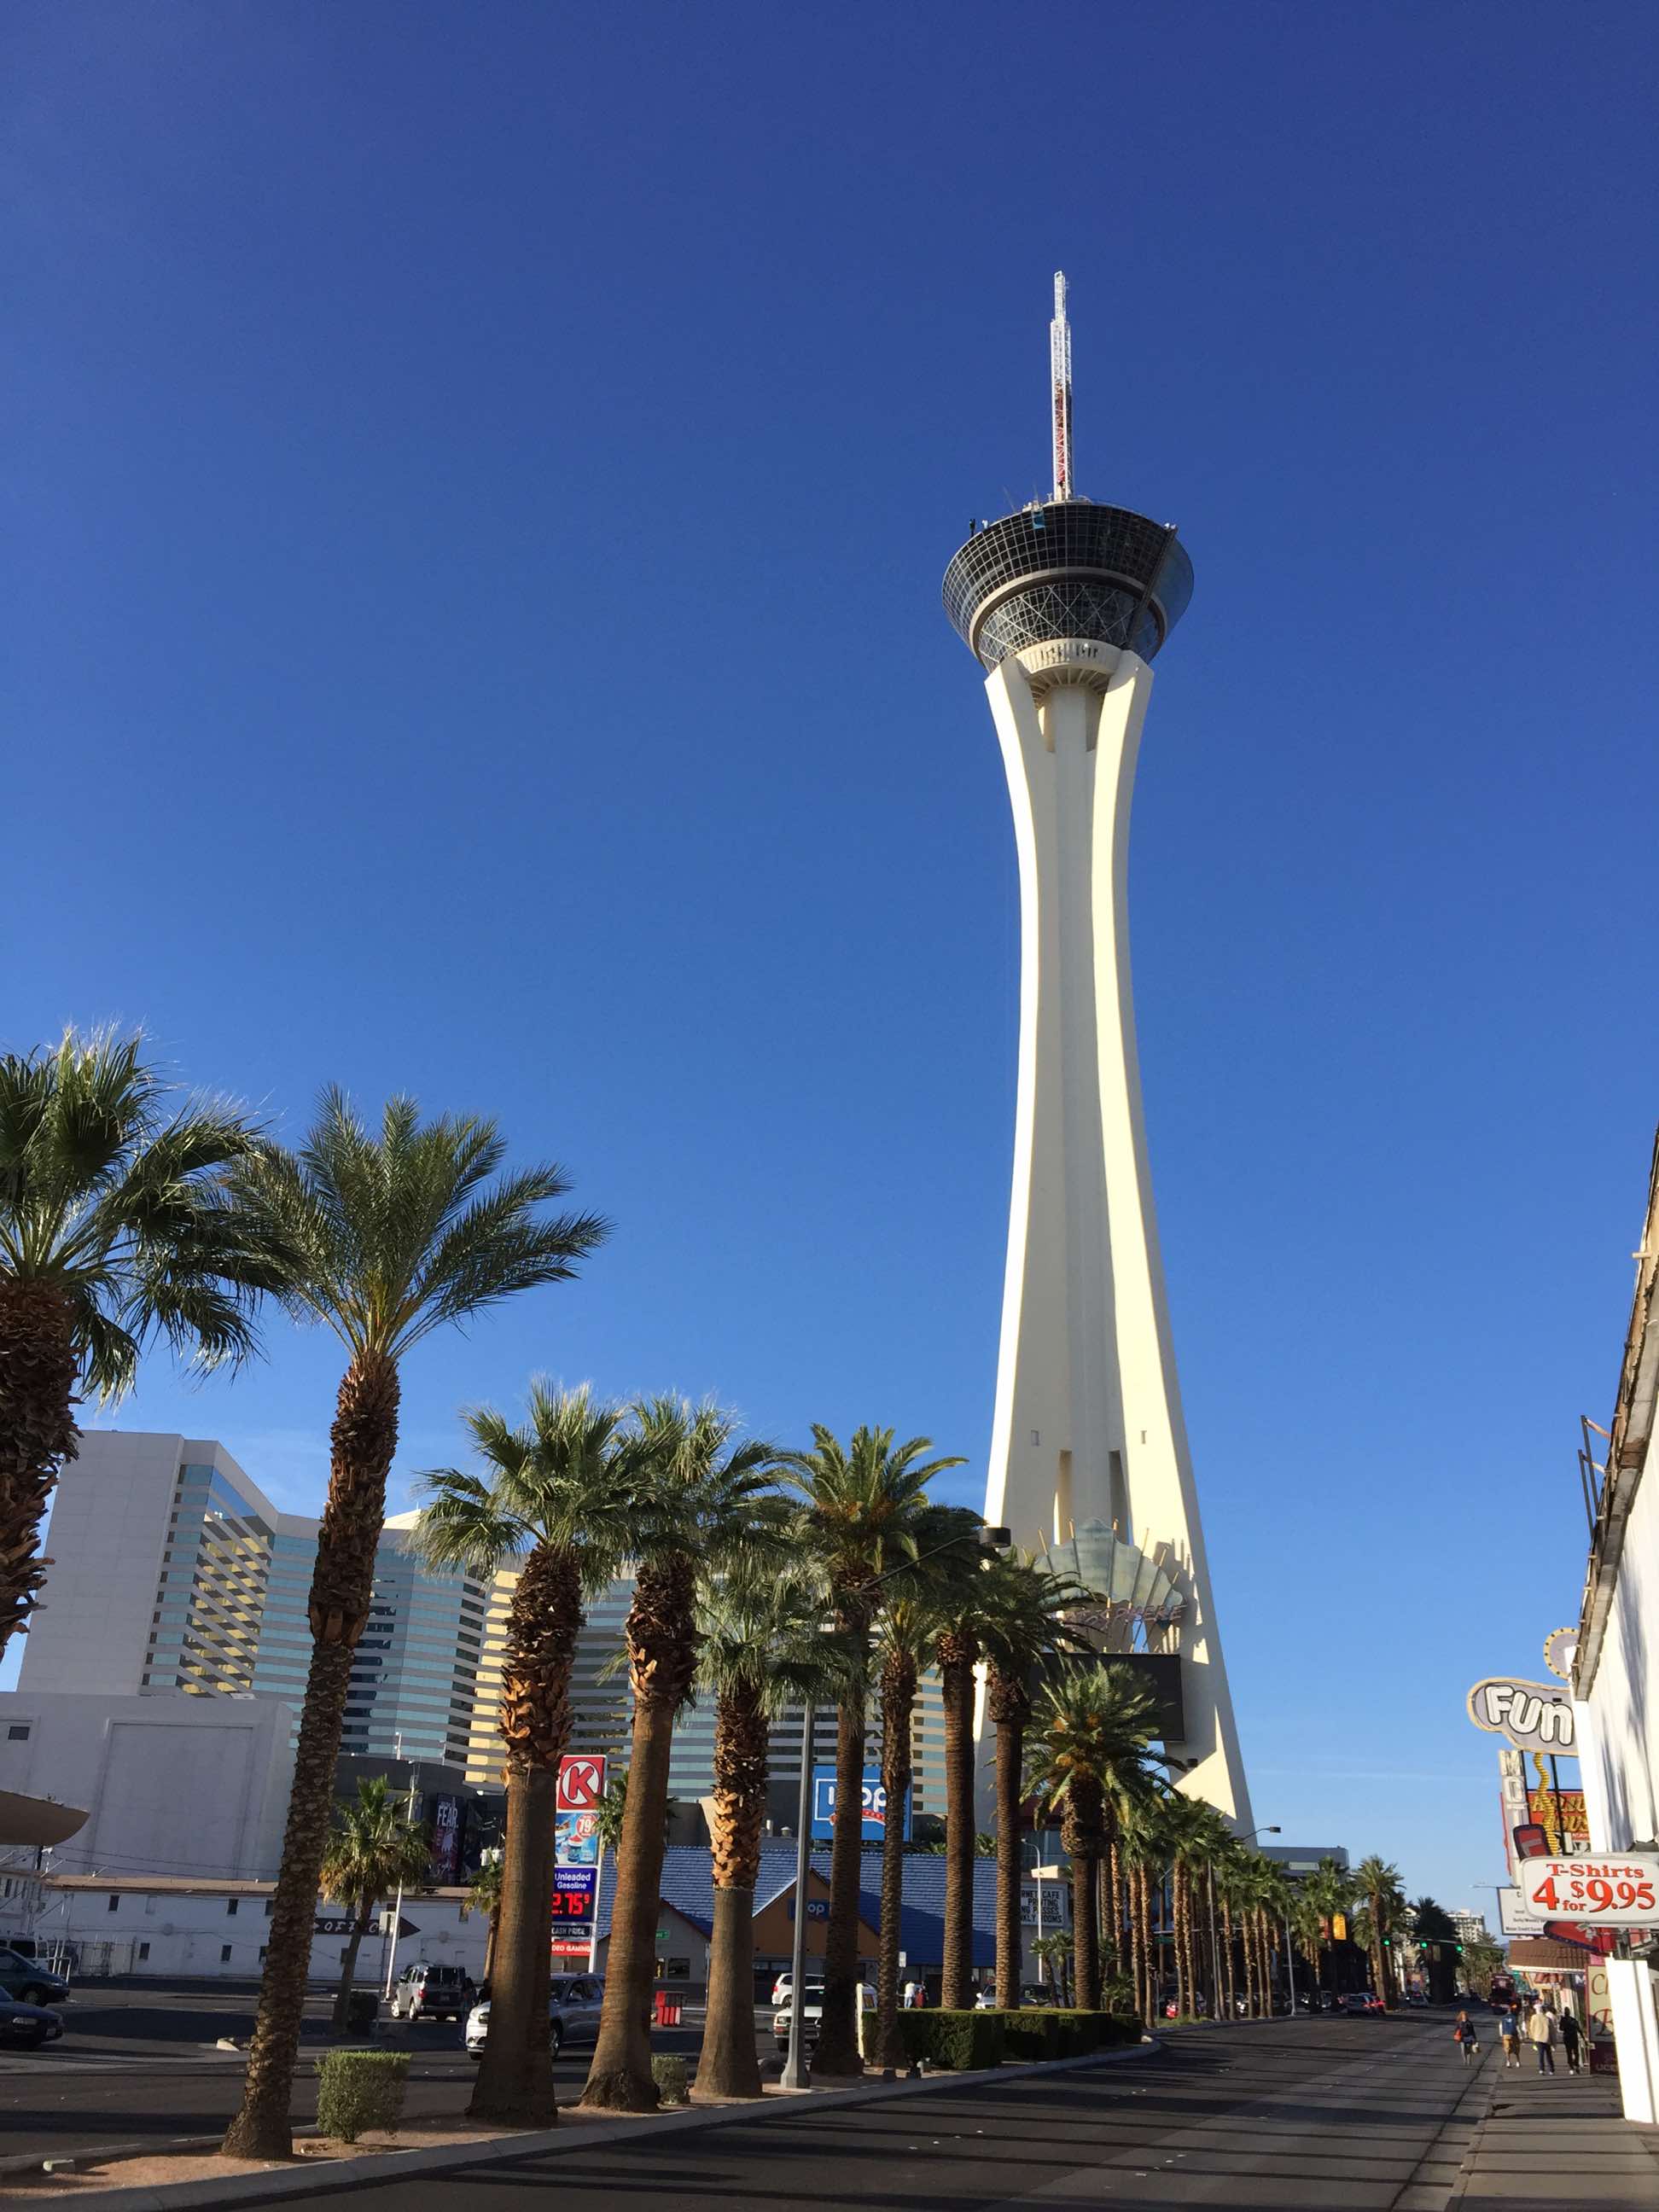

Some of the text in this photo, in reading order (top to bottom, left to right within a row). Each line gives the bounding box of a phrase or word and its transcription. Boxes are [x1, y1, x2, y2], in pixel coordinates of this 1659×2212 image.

[568, 1766, 595, 1801] K
[828, 1786, 887, 1813] IOP
[555, 1872, 591, 1881] Unleaded
[1545, 1864, 1644, 1878] T-Shirts
[556, 1881, 587, 1889] Gasoline
[1532, 1877, 1656, 1912] 4 for $9.95
